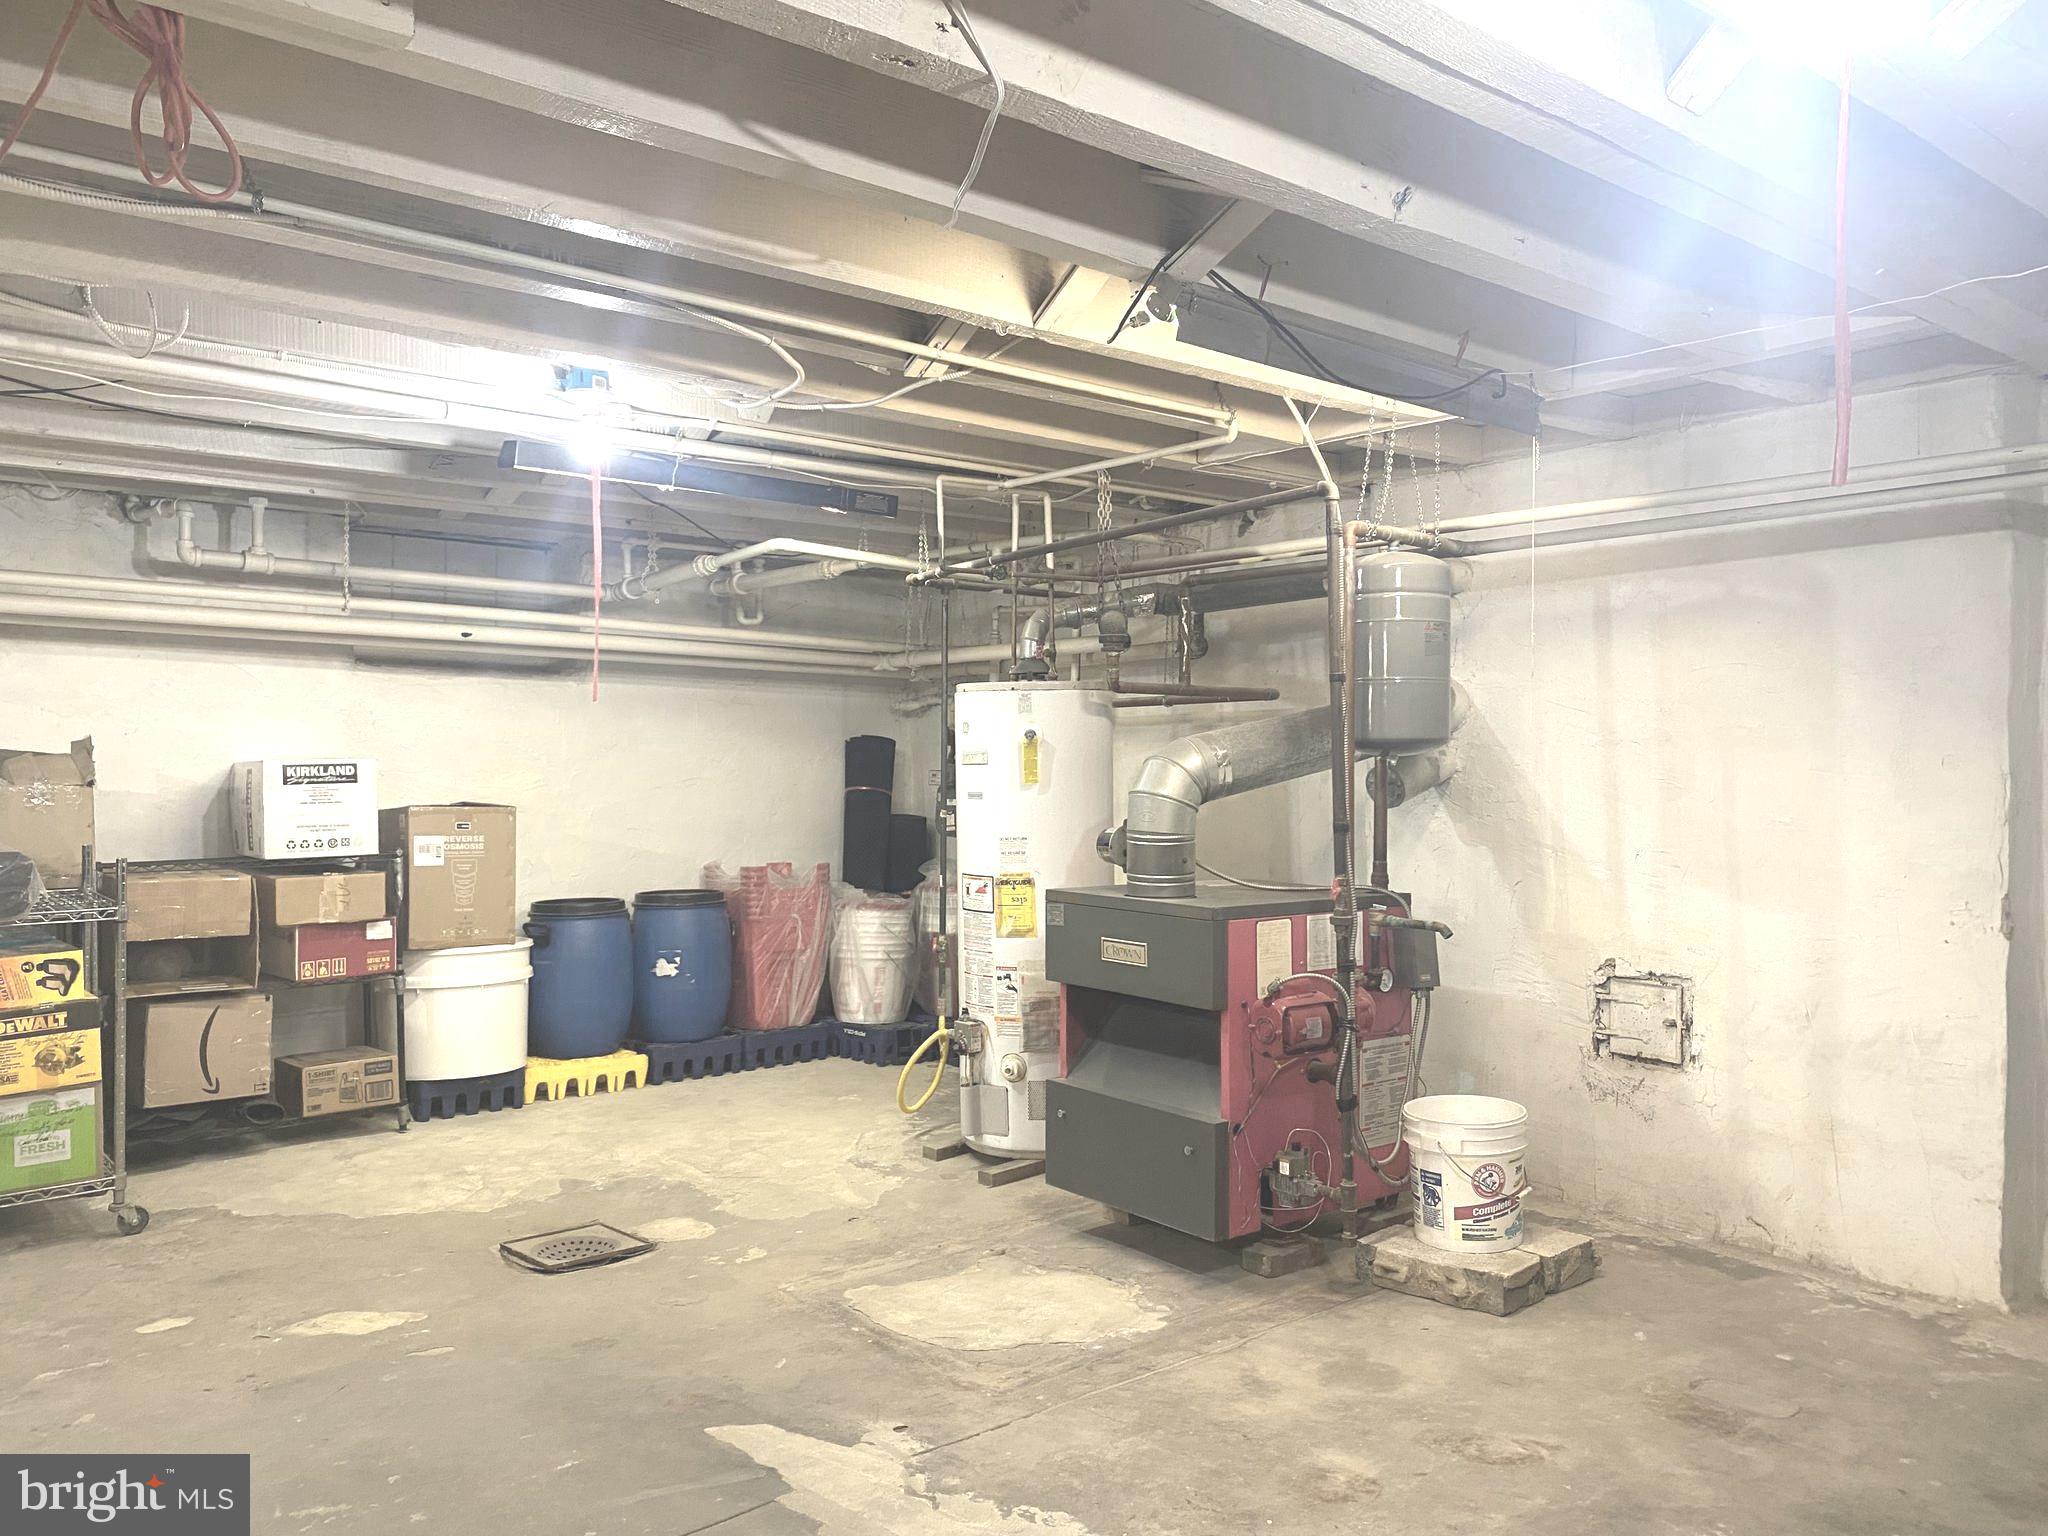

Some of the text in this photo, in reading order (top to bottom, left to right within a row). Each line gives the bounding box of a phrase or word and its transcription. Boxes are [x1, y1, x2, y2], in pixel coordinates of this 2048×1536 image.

[286, 765, 356, 777] KIRKLAND
[444, 842, 485, 851] OSMOSIS
[1105, 944, 1142, 960] CROWN
[20, 1139, 66, 1156] FRESH
[1472, 1199, 1512, 1216] Complete
